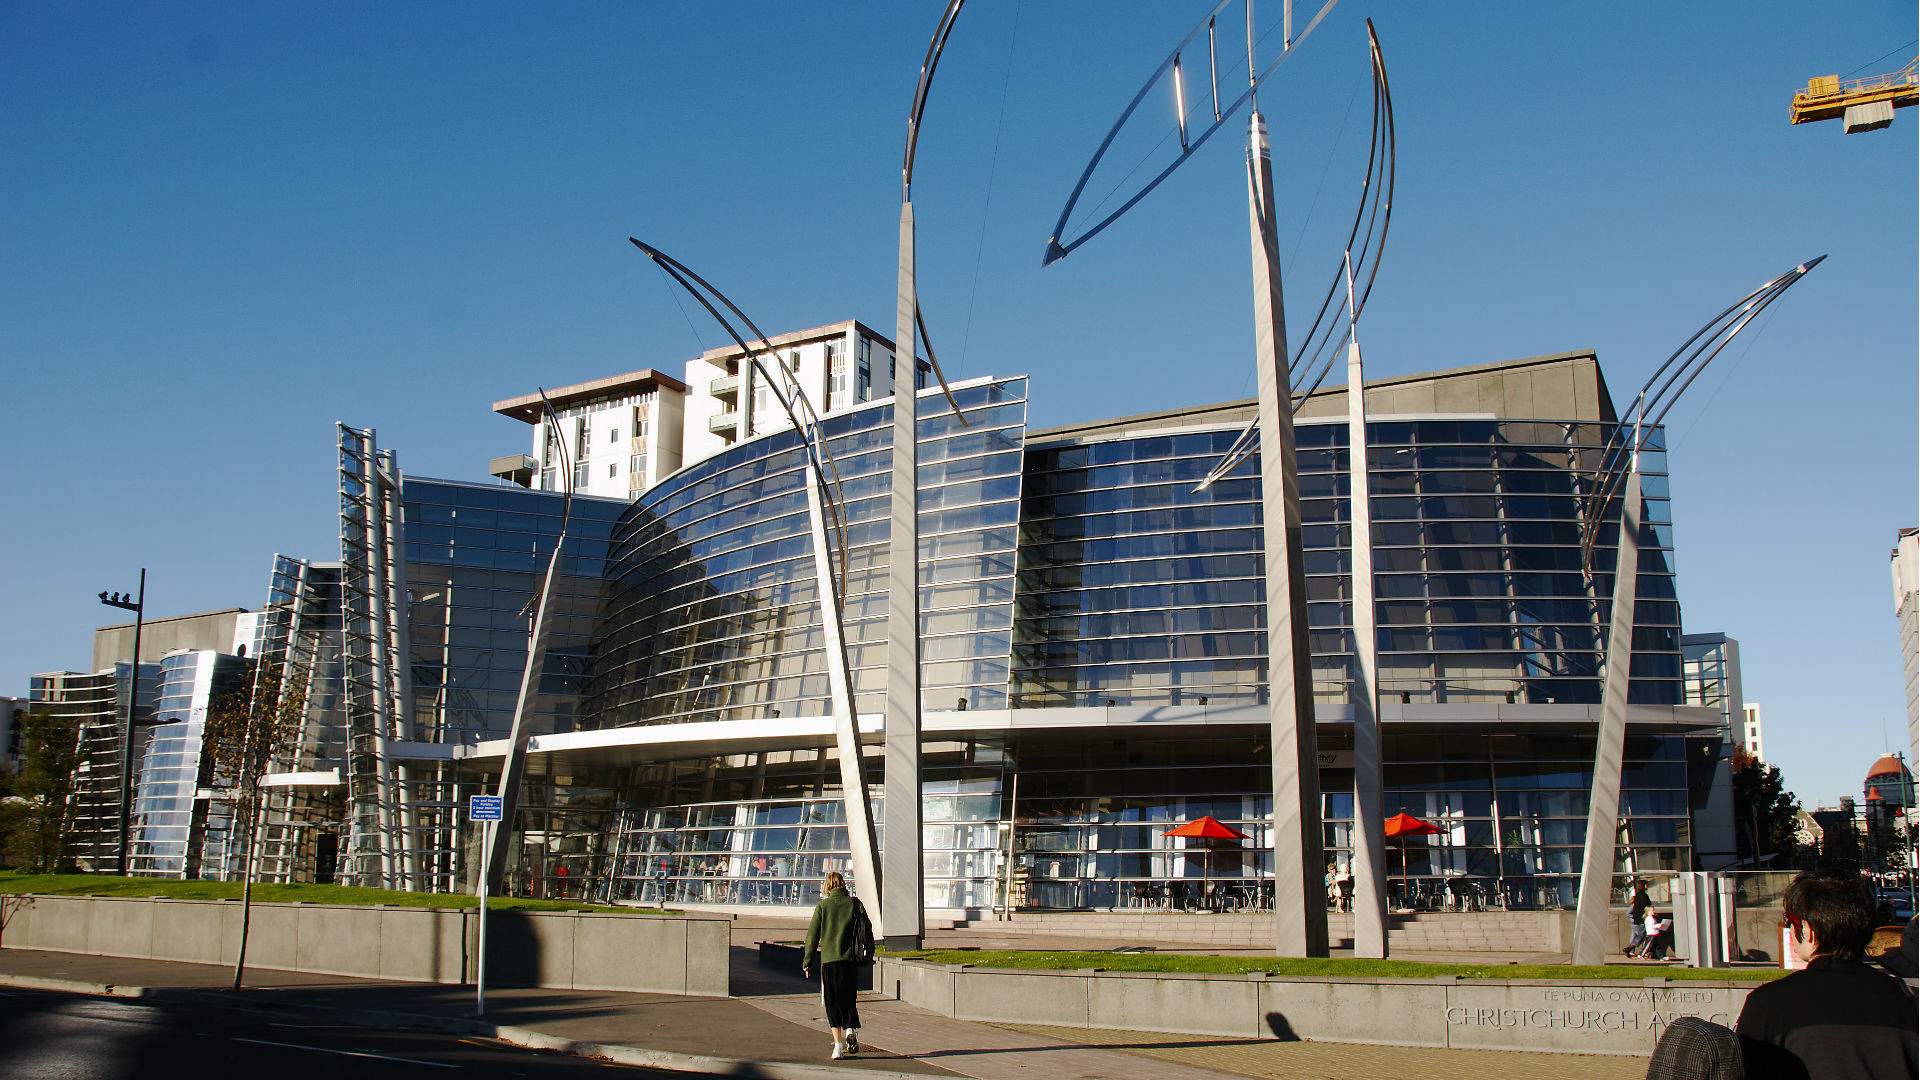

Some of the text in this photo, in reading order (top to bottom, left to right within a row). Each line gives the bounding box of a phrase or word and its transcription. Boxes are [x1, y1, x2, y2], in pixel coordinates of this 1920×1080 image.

[1543, 991, 1559, 1001] TE
[1563, 991, 1605, 1002] PUNA
[1609, 991, 1620, 1001] O
[1447, 1007, 1638, 1033] CHRISTCHURCH
